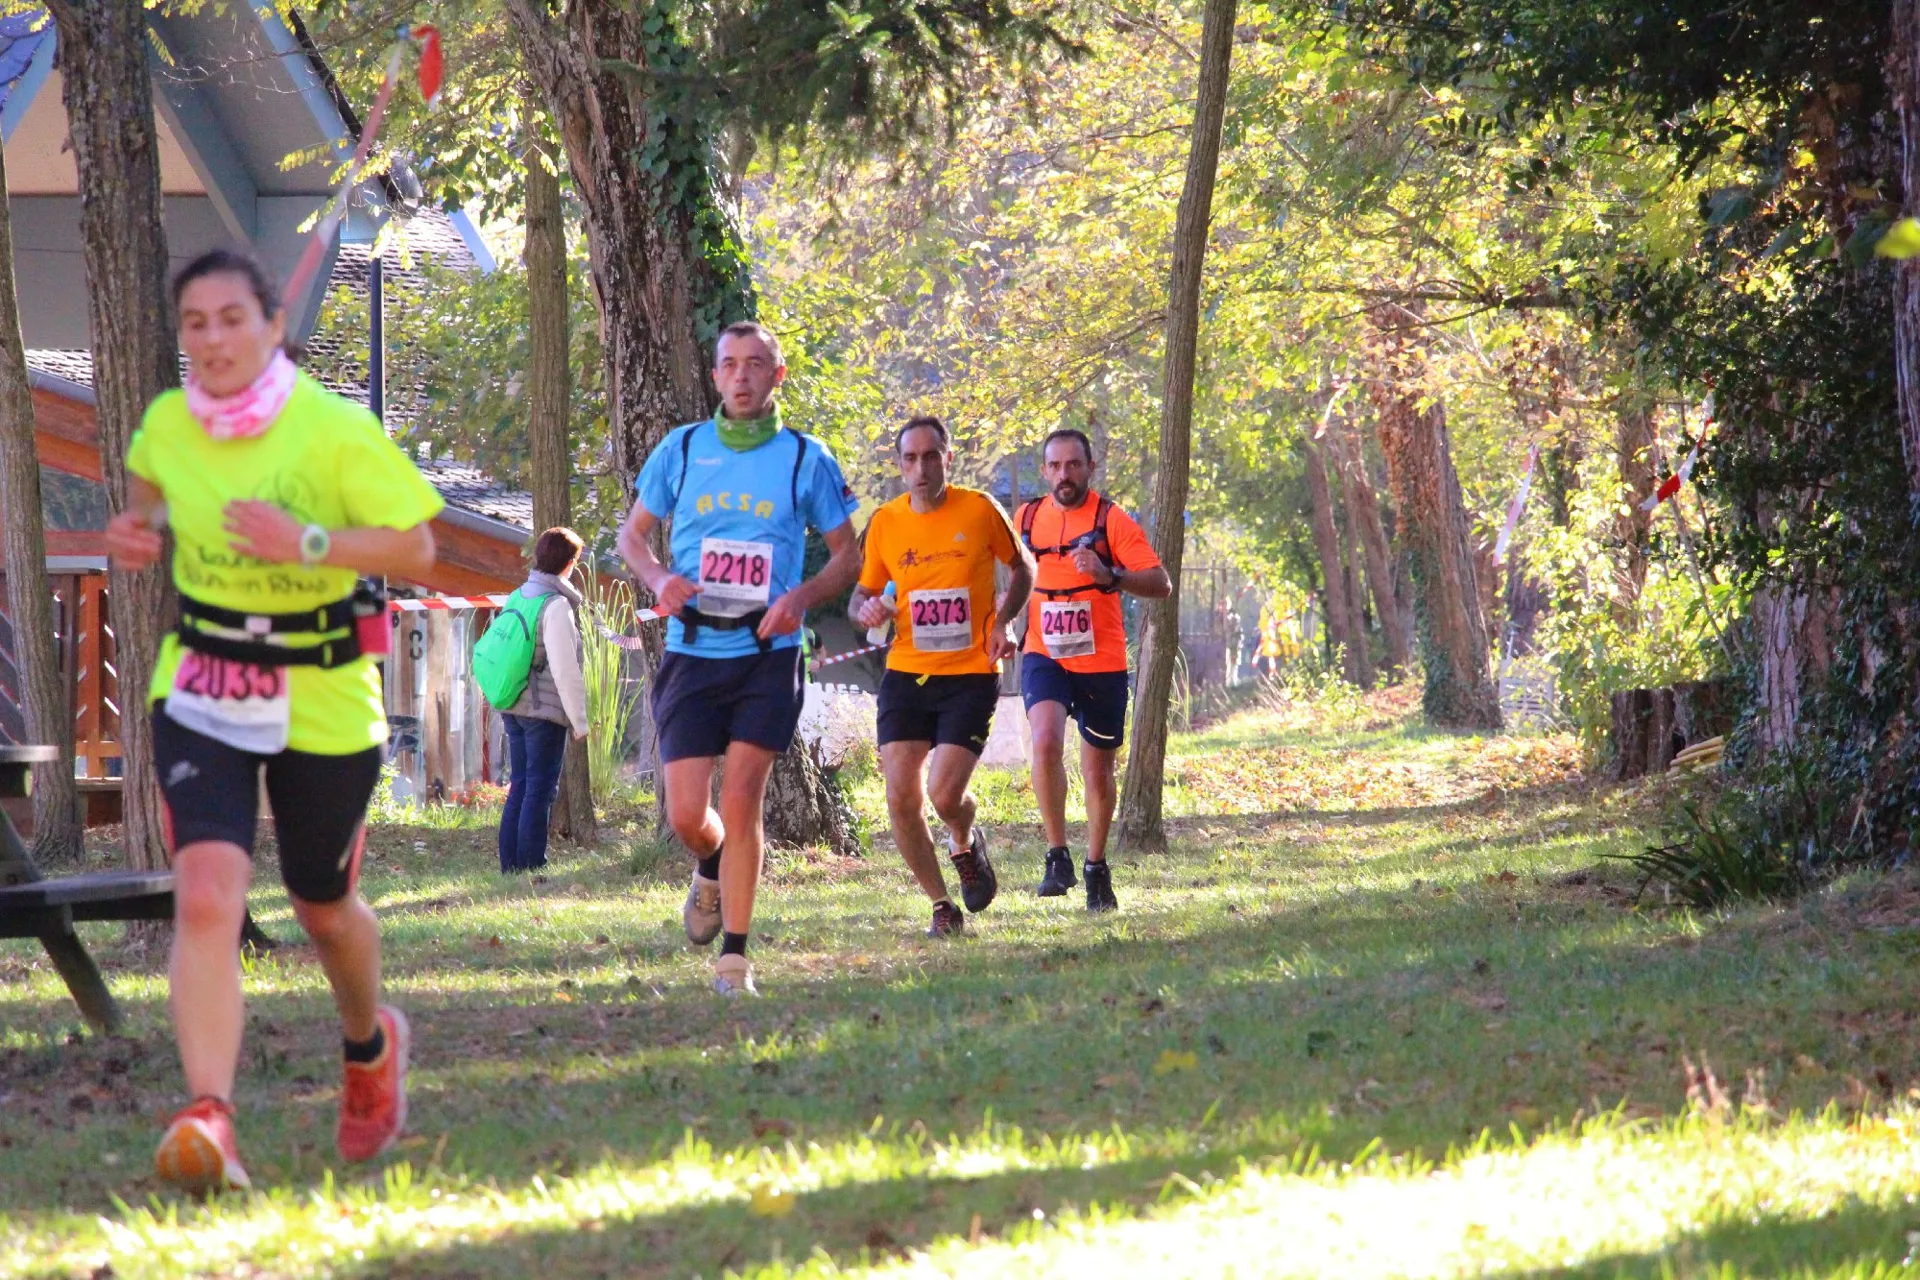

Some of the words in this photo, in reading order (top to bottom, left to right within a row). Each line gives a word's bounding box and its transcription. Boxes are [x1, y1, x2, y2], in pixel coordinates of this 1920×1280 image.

[696, 492, 775, 519] ACSA
[704, 550, 765, 587] 2218
[915, 596, 967, 626] 2373
[1044, 609, 1089, 635] 2476
